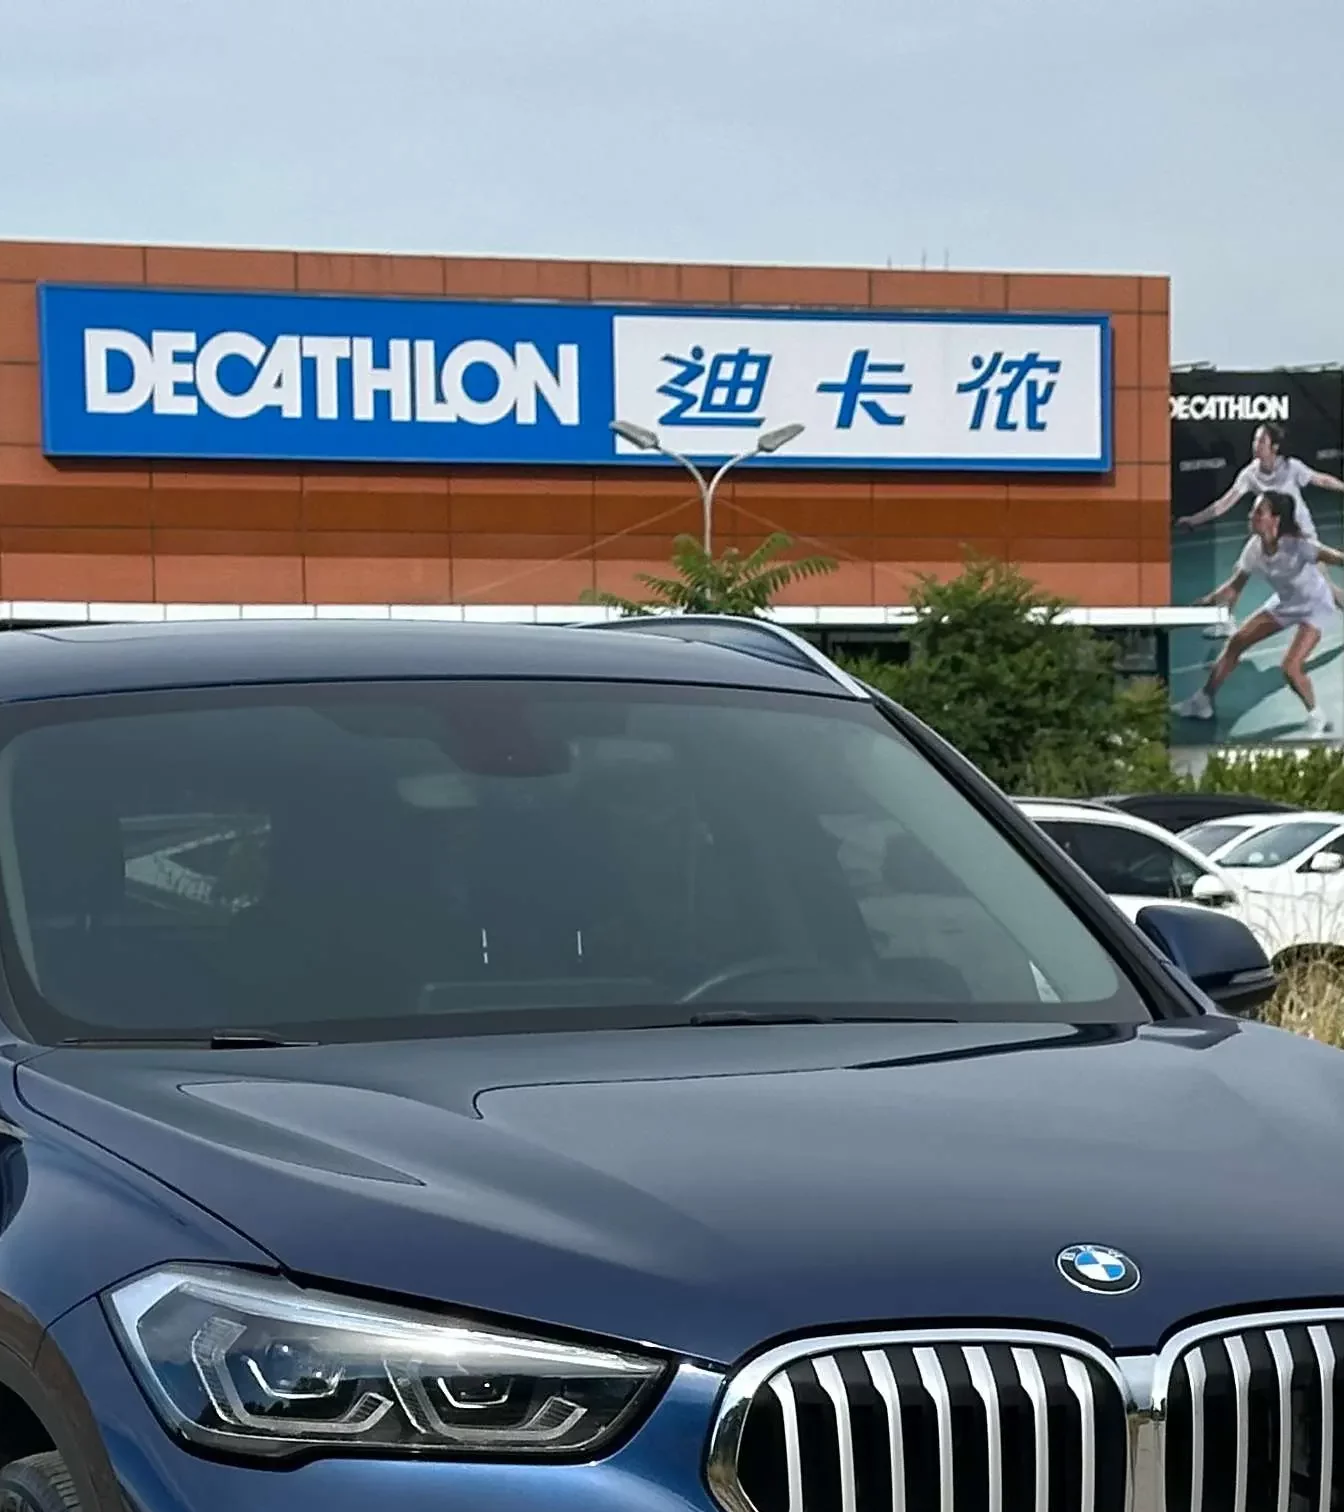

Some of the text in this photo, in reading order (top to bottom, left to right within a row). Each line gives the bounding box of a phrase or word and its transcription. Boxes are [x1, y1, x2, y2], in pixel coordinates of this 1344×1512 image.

[83, 328, 580, 426] DECATHLON
[657, 344, 1061, 432] 迪卡侬
